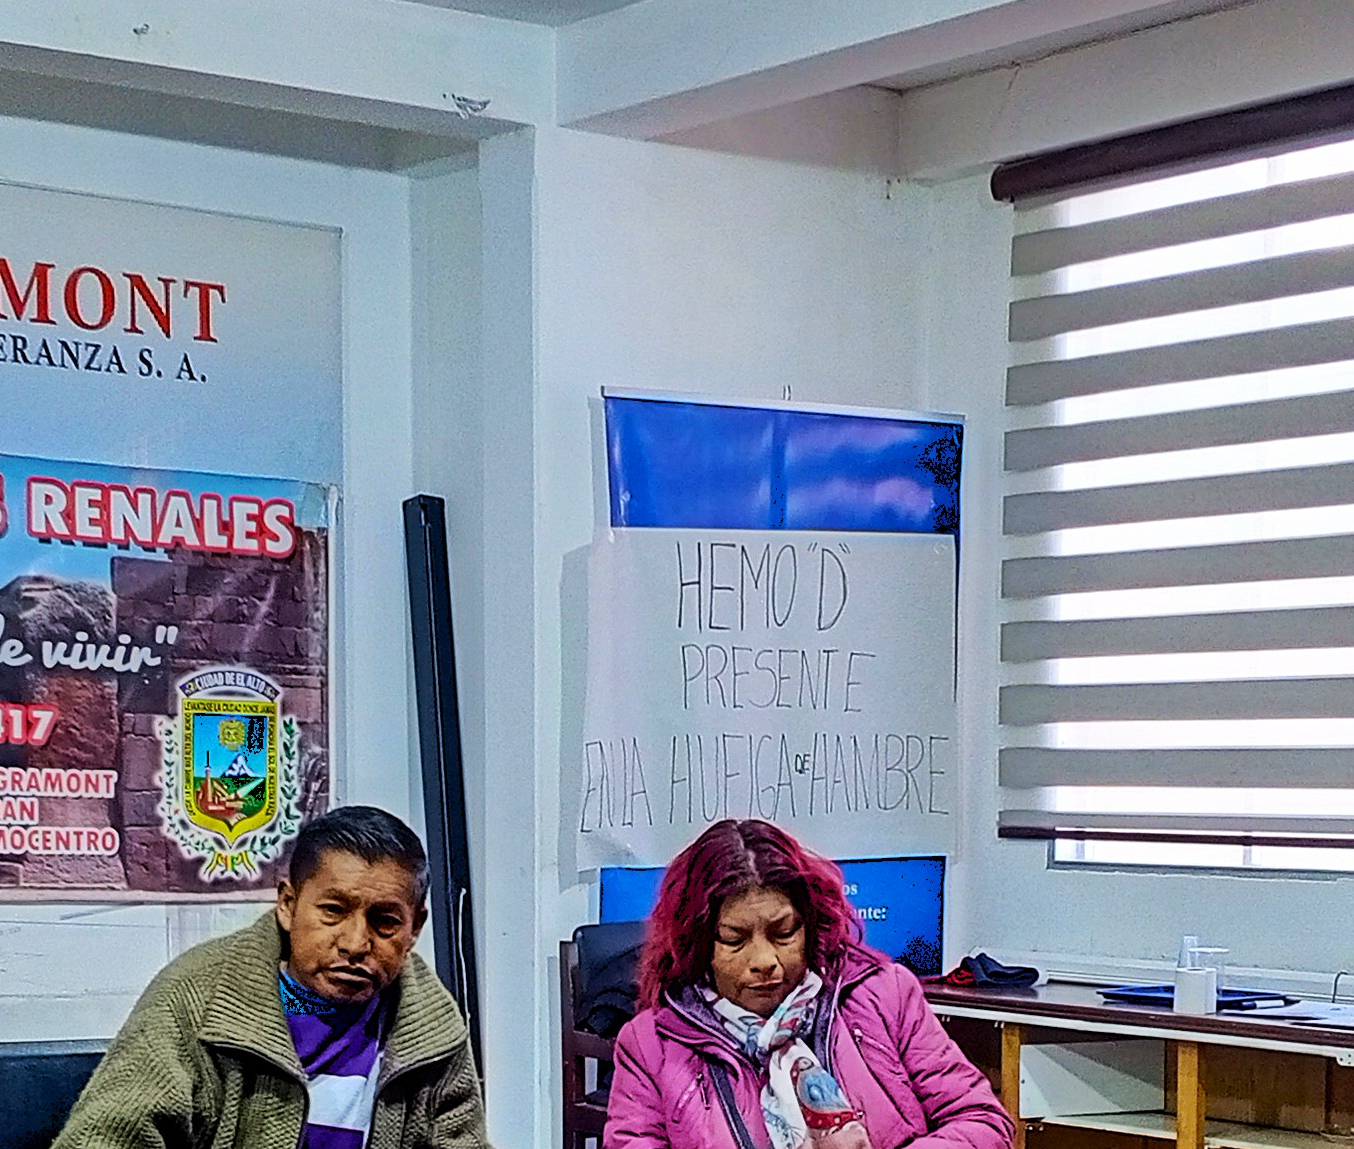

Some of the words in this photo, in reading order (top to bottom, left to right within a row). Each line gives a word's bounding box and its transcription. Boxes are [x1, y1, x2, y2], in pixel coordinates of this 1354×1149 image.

[136, 349, 163, 378] S.
[176, 353, 207, 383] A.
[27, 476, 296, 558] RENALES
[676, 540, 798, 634] HEMO
[225, 672, 235, 685] DE
[236, 672, 245, 686] EL
[246, 674, 266, 693] ALTO
[681, 643, 876, 713] PRESENTE
[794, 752, 811, 775] DE
[809, 732, 949, 816] HAMBRE
